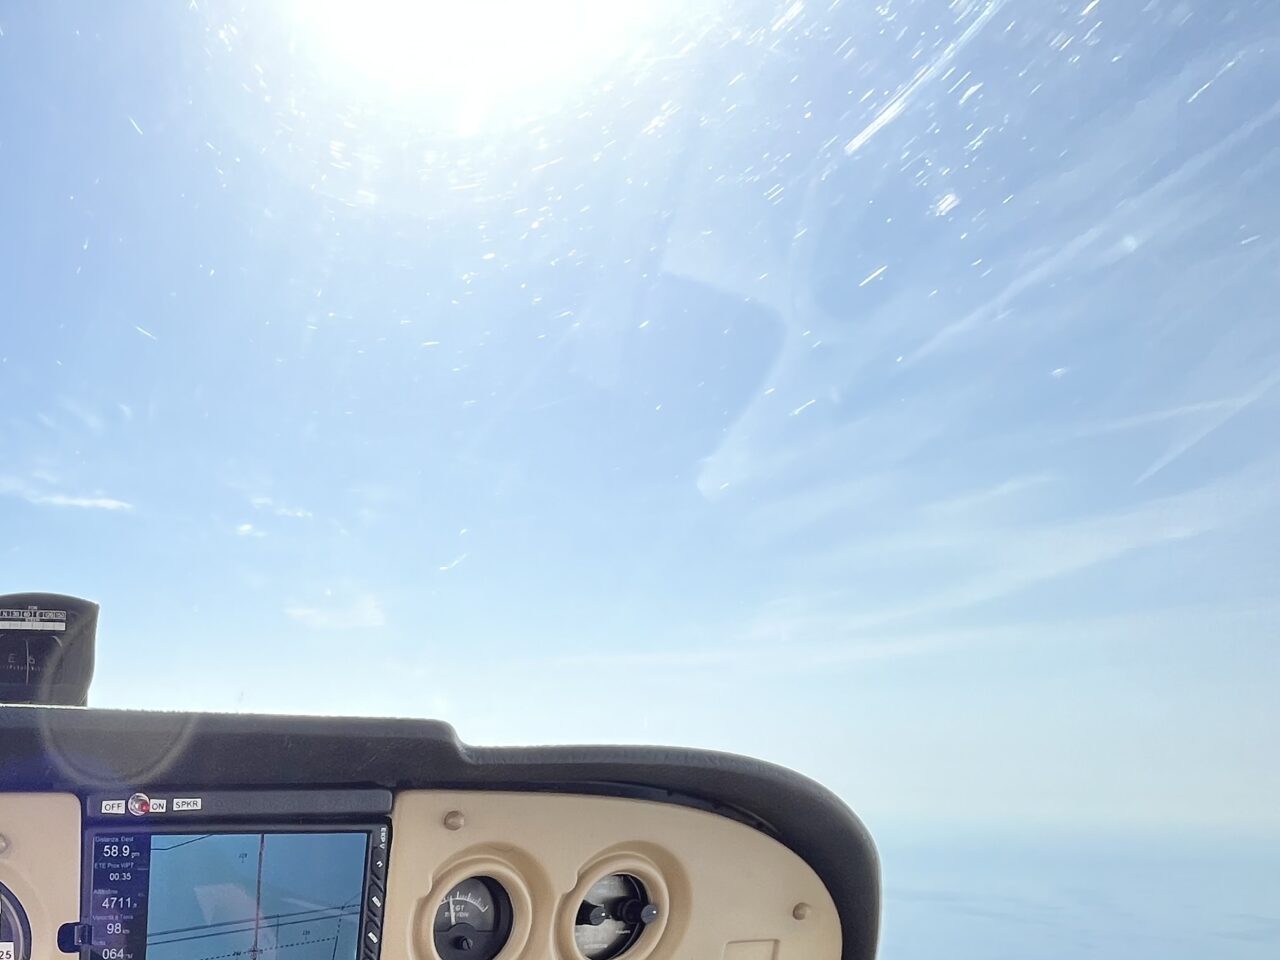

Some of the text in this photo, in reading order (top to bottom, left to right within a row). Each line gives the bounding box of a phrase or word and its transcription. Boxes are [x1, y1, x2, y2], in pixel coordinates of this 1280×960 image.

[104, 800, 199, 811] OFF ON SPKR
[102, 897, 131, 909] 4711
[106, 923, 122, 934] 98
[102, 948, 124, 959] 064
